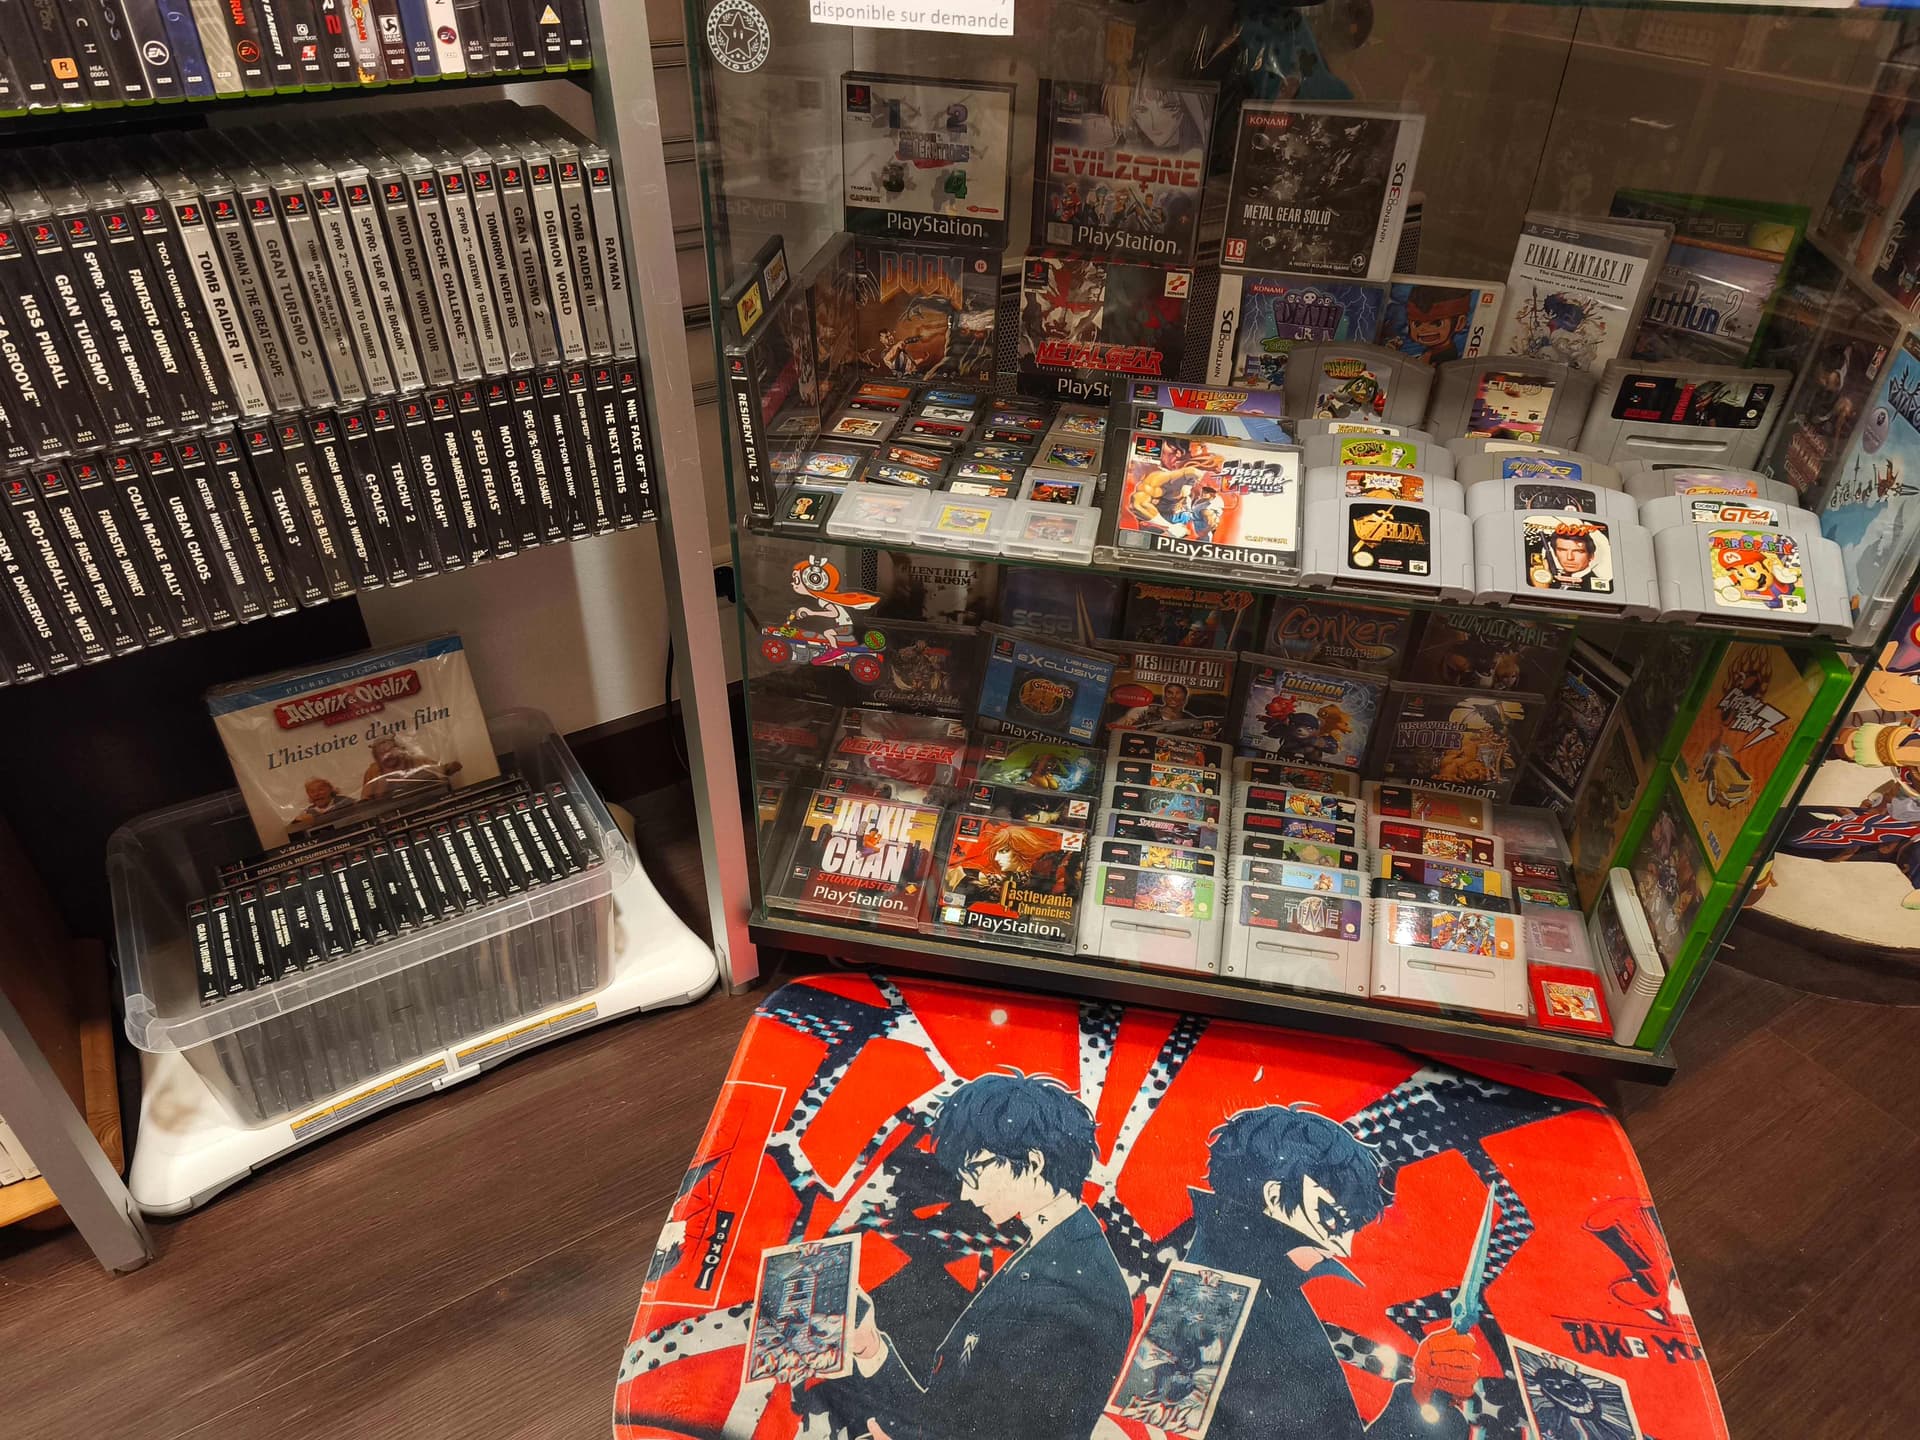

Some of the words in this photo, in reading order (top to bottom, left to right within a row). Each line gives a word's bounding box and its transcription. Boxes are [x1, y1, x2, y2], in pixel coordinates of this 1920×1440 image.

[812, 1, 895, 22] disponible
[900, 9, 926, 24] sur
[930, 8, 1009, 29] demande
[1248, 116, 1289, 126] KONAMI
[513, 205, 530, 245] GRAN
[887, 212, 983, 238] PlayStation
[1244, 204, 1274, 221] METAL
[1276, 206, 1302, 223] GEAR
[1303, 209, 1331, 226] SOLID
[226, 231, 246, 274] RAYMAN
[427, 211, 450, 270] PORSCHE
[568, 202, 585, 243] TOMB
[577, 243, 594, 294] RAIDER
[1078, 225, 1177, 255] PlayStation
[1227, 241, 1245, 258] 18
[83, 251, 105, 289] SPYRO:
[361, 216, 376, 253] SPYRO:
[371, 252, 383, 281] YEAR
[379, 280, 389, 297] OF
[384, 296, 394, 316] THE
[456, 206, 469, 236] SPYRO
[467, 252, 483, 290] GATEWAY
[478, 302, 495, 340] GLIMMER
[484, 210, 507, 271] TOMORROW
[498, 270, 512, 305] NEVER
[506, 301, 519, 329] DIES
[521, 246, 541, 308] TURISMO
[543, 209, 564, 269] DIGIMON
[554, 270, 573, 317] WORLD
[604, 236, 622, 291] RAYMAN
[1525, 243, 1560, 269] FINAL
[1563, 251, 1618, 281] FANTASY
[1619, 263, 1634, 284] IV
[55, 273, 82, 318] GRAN
[242, 277, 250, 287] 2
[244, 286, 255, 307] THE
[266, 238, 287, 280] GRAN
[279, 284, 309, 347] TURISMO
[329, 221, 345, 250] SPYRO
[344, 269, 362, 309] GATEWAY
[358, 319, 377, 360] GLIMMER
[395, 214, 412, 246] MOTO
[414, 289, 432, 321] WORLD
[423, 319, 440, 353] TOUR
[1252, 283, 1285, 294] KONAMI
[99, 290, 119, 319] YEAR
[197, 251, 221, 294] TOMB
[213, 297, 240, 351] RAIDER
[110, 319, 123, 336] OF
[128, 268, 160, 327] FANTASTIC
[150, 328, 178, 375] JOURNEY
[156, 241, 172, 266] TOCA
[166, 268, 186, 311] TOURING
[179, 311, 193, 332] CAR
[188, 331, 219, 396] CHAMPIONSHIP
[252, 305, 272, 340] GREAT
[20, 294, 44, 329] KISS
[36, 331, 69, 390] PINBALL
[116, 335, 132, 357] THE
[263, 340, 285, 378] ESCAPE
[1036, 341, 1103, 362] METAL
[1102, 346, 1163, 375] GEAR
[553, 413, 564, 437] MIKE
[603, 402, 615, 425] THE
[737, 392, 754, 446] RESIDENT
[471, 428, 489, 466] SPEED
[499, 424, 515, 459] MOTO
[522, 409, 534, 430] SPEC
[531, 448, 546, 478] COVERT
[557, 436, 571, 465] TYSON
[608, 427, 620, 456] NEXT
[630, 424, 643, 451] FACE
[295, 462, 308, 475] LE
[420, 454, 438, 487] ROAD
[745, 446, 758, 470] EVIL
[299, 474, 318, 509] MONDE
[323, 445, 340, 473] CRASH
[332, 473, 356, 519] BANDICOOT
[444, 431, 469, 501] PARIS-MARSEILLE
[461, 500, 477, 529] RACING
[612, 457, 627, 495] TETRIS
[750, 475, 759, 483] 2
[127, 486, 152, 521] COLIN
[142, 522, 169, 562] McRAE
[169, 496, 196, 540] URBAN
[228, 470, 240, 490] PRO
[234, 490, 256, 527] PINBALL
[249, 526, 261, 543] BIG
[255, 542, 269, 566] RACE
[263, 565, 276, 584] USA
[271, 487, 297, 535] TEKKEN
[311, 507, 325, 526] DES
[405, 514, 416, 523] 2
[59, 506, 84, 543] SHERIF
[74, 543, 103, 583] FAIS-MOI
[93, 582, 114, 609] PEUR
[98, 508, 129, 560] FANTASTIC
[119, 558, 147, 599] JOURNEY
[209, 511, 233, 552] MAXIMUM
[225, 550, 246, 586] GAUDIUM
[1156, 535, 1278, 565] PlayStation
[1712, 536, 1754, 550] MARIO
[1754, 540, 1795, 555] PARTY
[7, 564, 20, 575] &
[934, 577, 971, 587] ROOM
[13, 575, 53, 640] DANGEROUS
[75, 615, 96, 643] WEB
[1280, 606, 1399, 648] Conker
[1065, 658, 1110, 674] UBISOFT
[1135, 655, 1197, 674] RESIDENT
[1199, 661, 1225, 679] EVIL
[1137, 672, 1198, 687] DIRECTOR'S
[1199, 679, 1221, 689] CUT
[281, 692, 346, 725] Astérix
[357, 675, 413, 703] Obélix
[1285, 678, 1346, 696] DIGIMON
[267, 734, 359, 771] L'histoire
[366, 717, 407, 742] d'un
[413, 706, 451, 730] film
[1397, 731, 1463, 749] NOIR
[1400, 721, 1466, 733] DISCWORLD
[904, 744, 958, 765] GEAR
[1410, 778, 1497, 799] PlayStation
[833, 799, 917, 844] JACKIE
[820, 836, 908, 883] CHAN
[1170, 858, 1195, 872] HULK
[813, 885, 904, 911] PlayStation
[816, 873, 897, 892] STUNTMASTER
[1001, 879, 1073, 912] Castlevania
[968, 911, 1062, 939] PlayStation
[1017, 901, 1072, 920] Chronicles
[1284, 898, 1341, 931] TIME
[1561, 1321, 1649, 1360] TAKE
